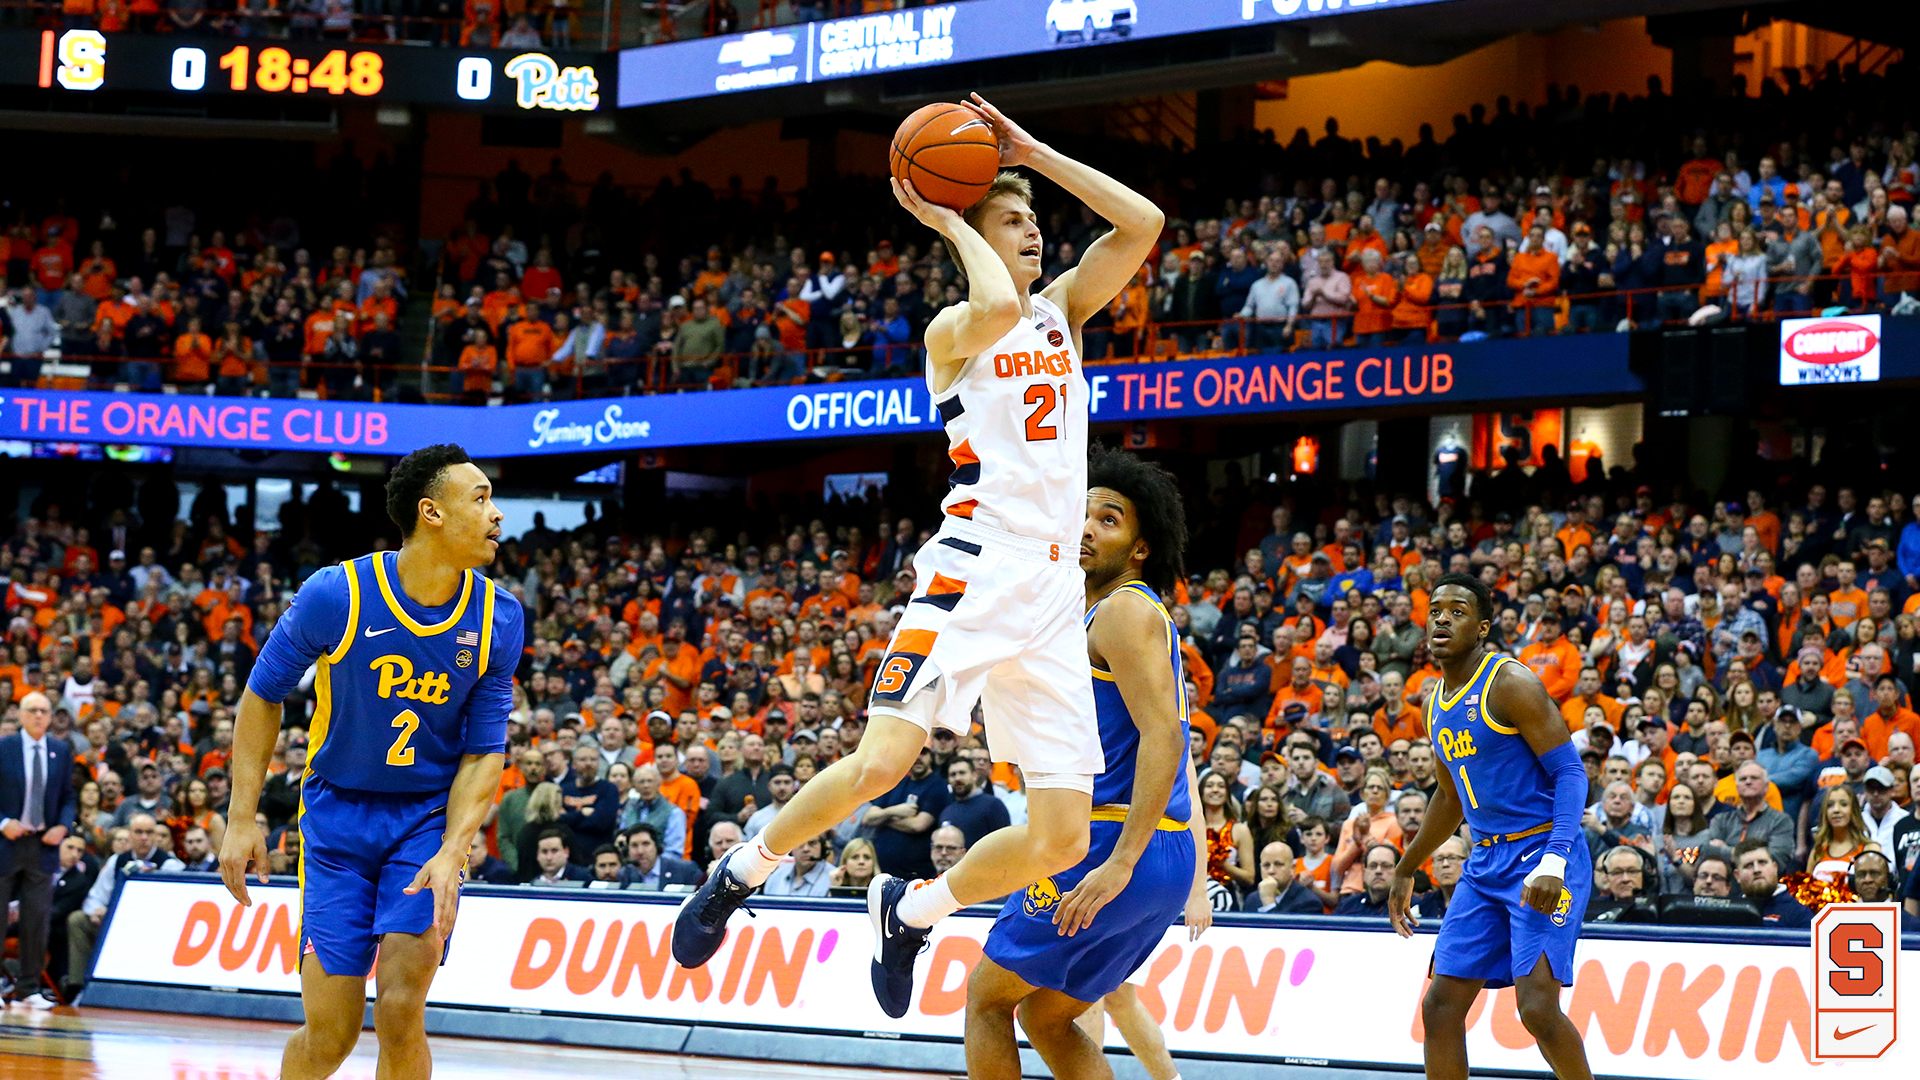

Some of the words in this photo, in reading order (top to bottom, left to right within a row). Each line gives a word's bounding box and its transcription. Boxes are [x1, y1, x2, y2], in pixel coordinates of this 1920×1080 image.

[821, 13, 919, 52] CENTRAL
[923, 6, 956, 38] NY
[57, 29, 106, 91] S
[171, 47, 206, 91] 0
[219, 46, 384, 96] 18:48
[820, 46, 875, 75] CHEVY
[877, 37, 952, 67] DEALERS
[457, 57, 492, 100] 0
[505, 52, 598, 111] Pitt
[1794, 331, 1868, 355] COMFORT
[1117, 371, 1184, 411] THE
[1194, 360, 1344, 407] ORANGE
[1355, 353, 1454, 396] CLUB
[1797, 364, 1863, 381] WINDOWS
[13, 397, 91, 434] THE
[102, 401, 270, 442] ORANGE
[282, 408, 389, 446] CLUB
[528, 408, 593, 447] Turning
[595, 404, 651, 443] Stone
[787, 387, 921, 431] OFFICIAL
[1050, 544, 1060, 561] S
[369, 654, 451, 705] Pitt
[876, 656, 914, 694] S
[386, 708, 420, 766] 2
[1438, 727, 1477, 762] Pitt
[1459, 765, 1479, 809] 1
